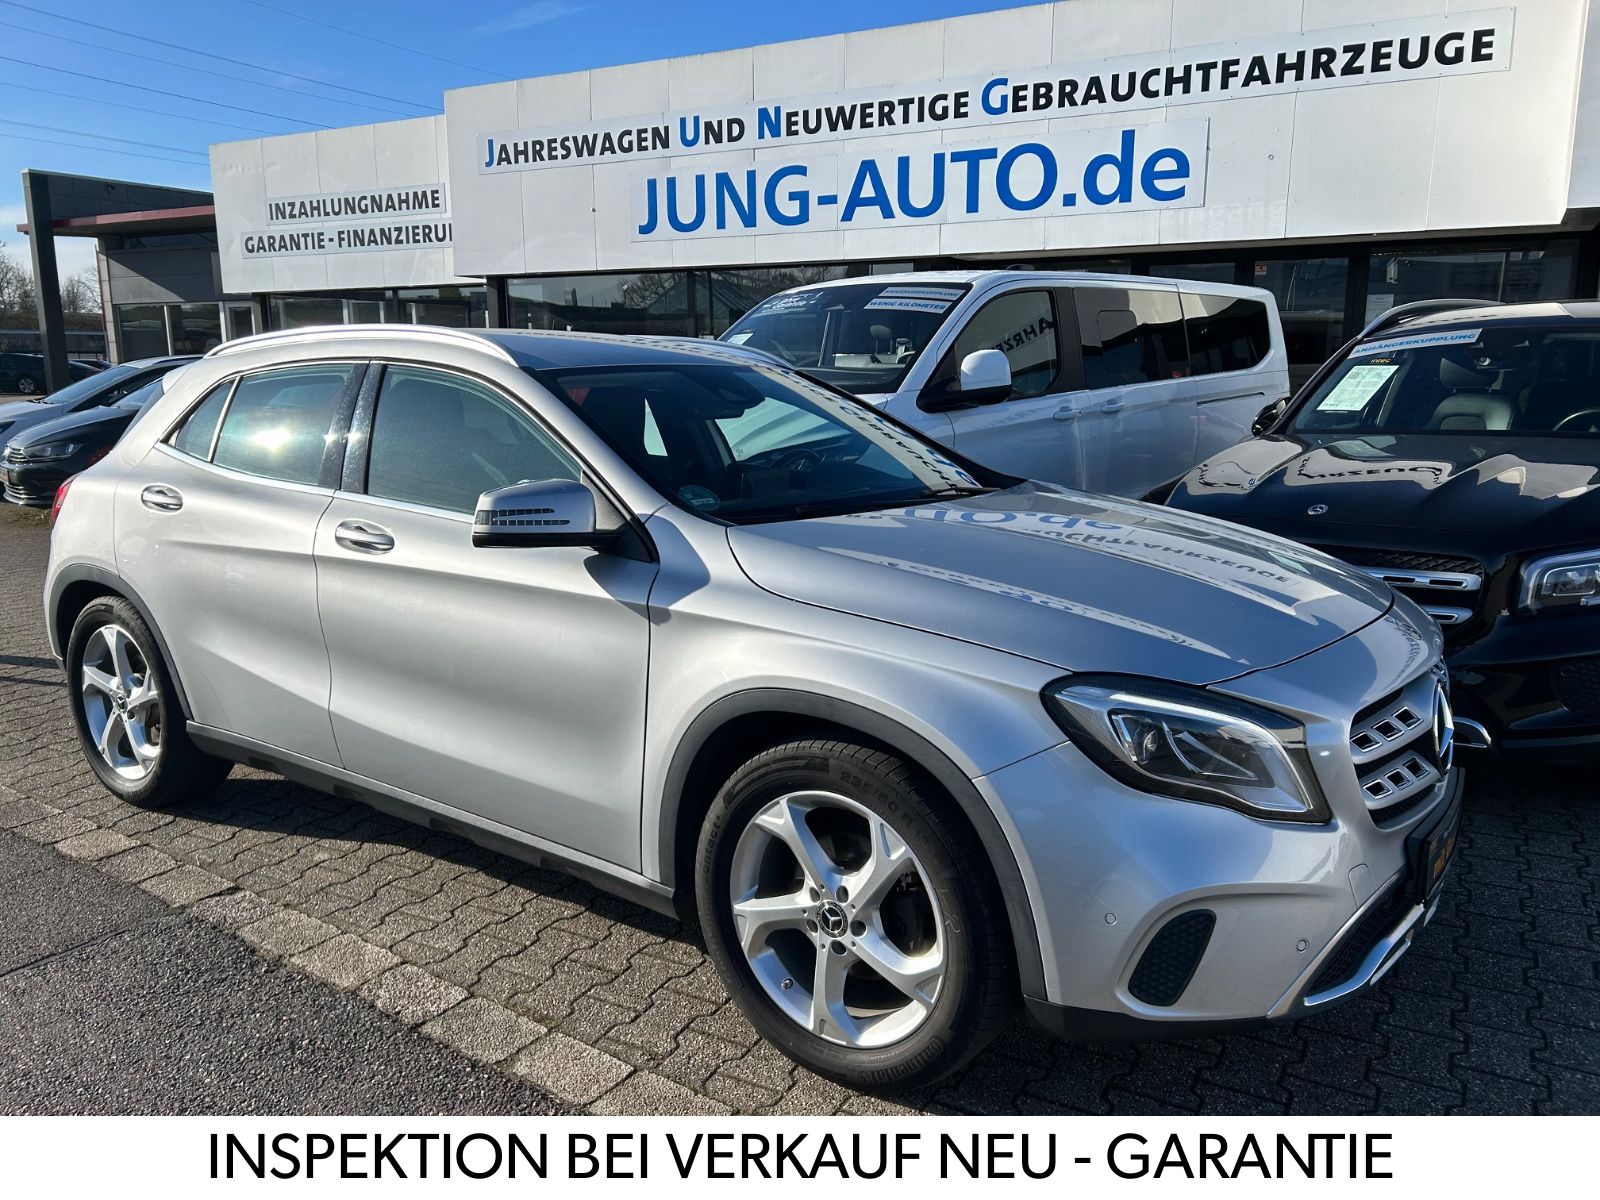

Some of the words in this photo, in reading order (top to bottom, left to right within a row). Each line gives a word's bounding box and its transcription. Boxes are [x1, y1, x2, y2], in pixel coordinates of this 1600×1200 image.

[484, 125, 670, 168] JAHRESWAGEN
[679, 115, 746, 148] UND
[757, 90, 970, 140] NEUWERTIGE
[981, 28, 1495, 116] GEBRAUCHTFAHRZEUGE
[638, 129, 1191, 235] JUNG-AUTO.de
[268, 189, 441, 221] INZAHLUNGNAHME
[898, 302, 947, 310] KILOMETER
[1354, 333, 1477, 353] ANHÄNGERKUPPLUNG
